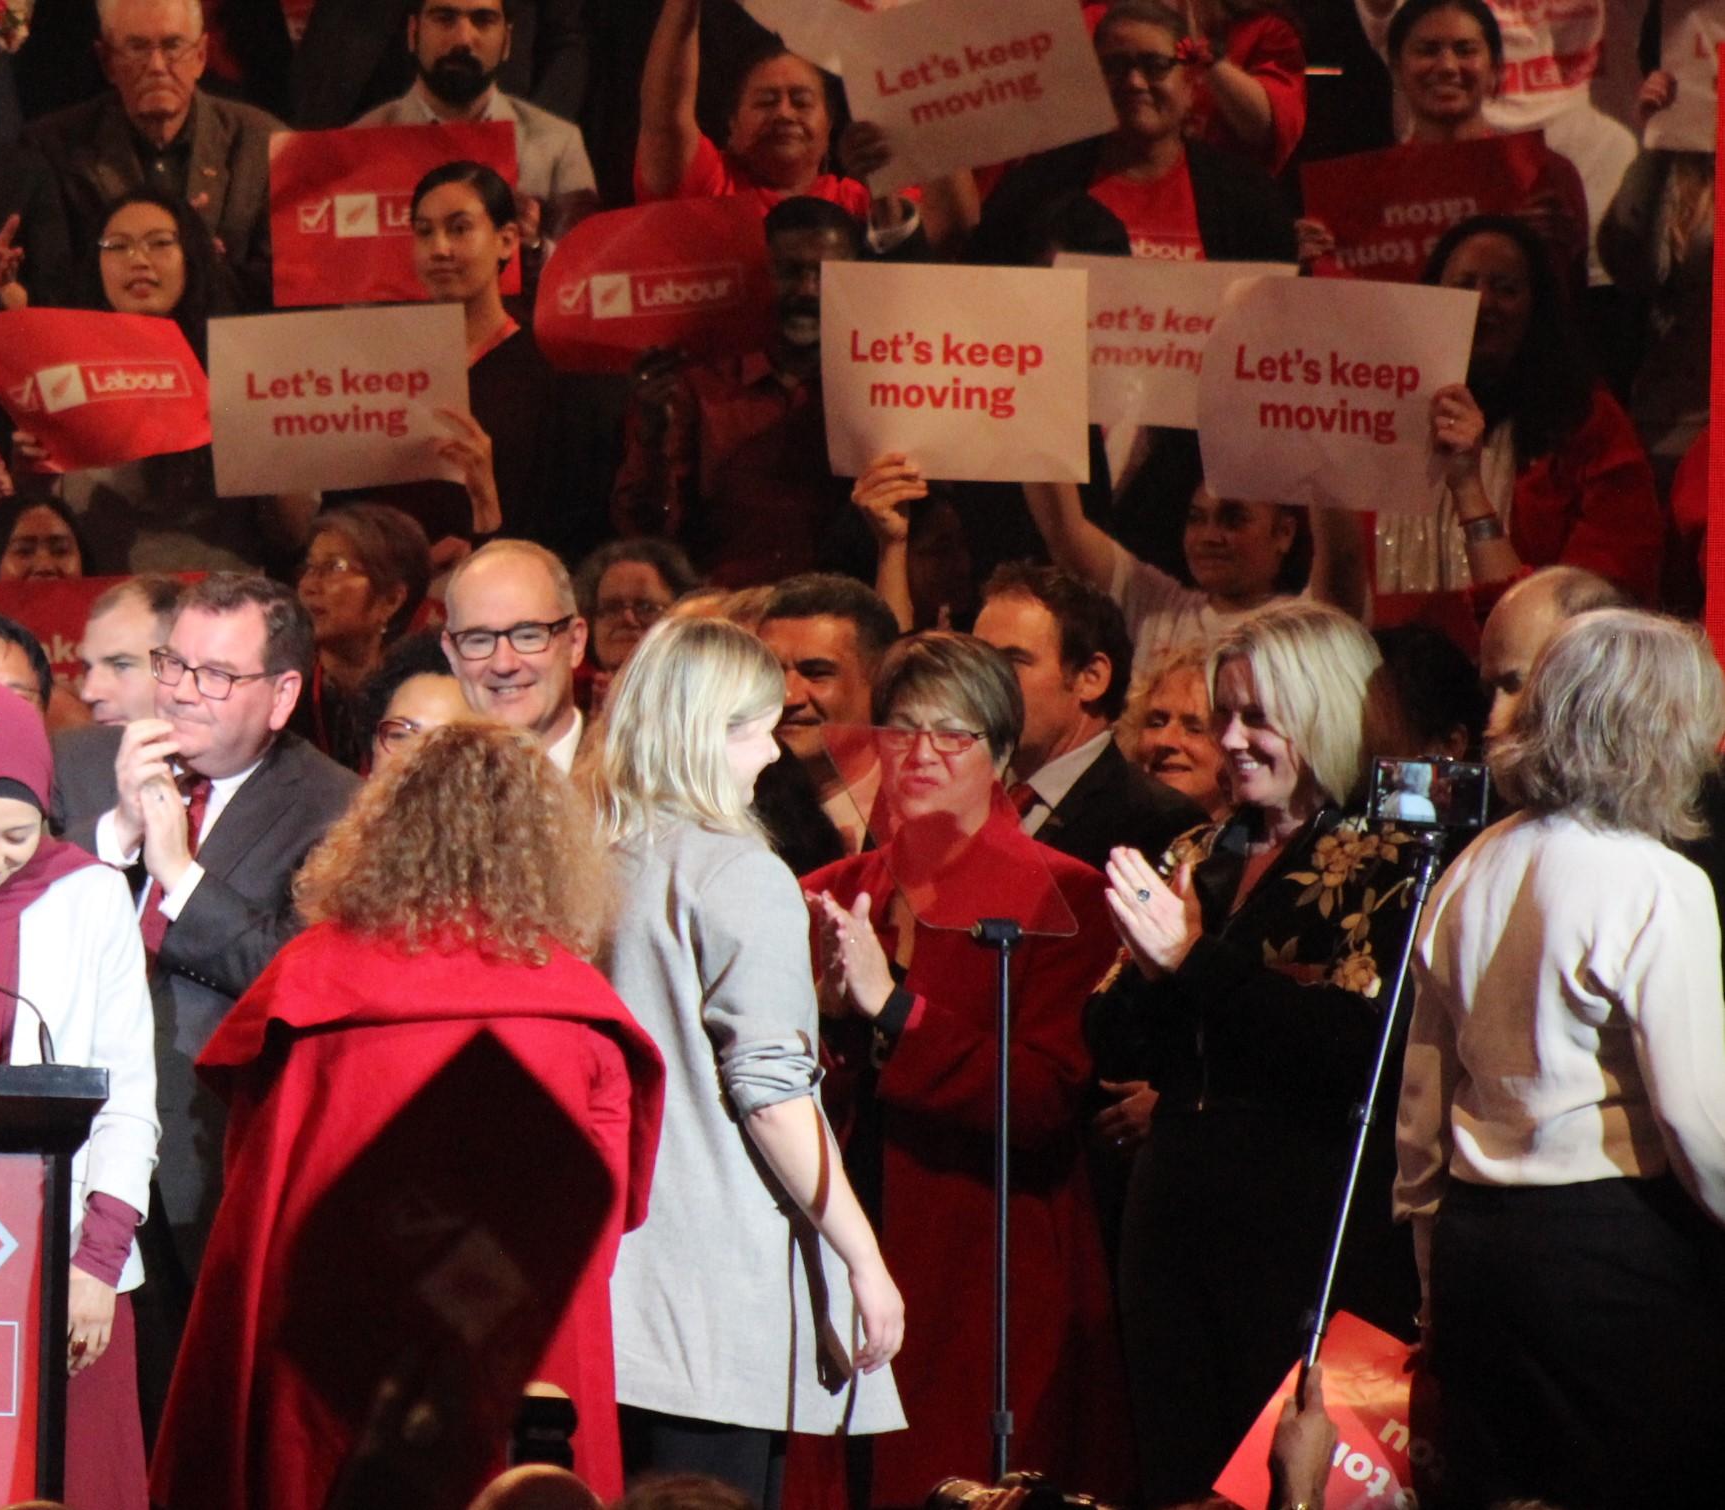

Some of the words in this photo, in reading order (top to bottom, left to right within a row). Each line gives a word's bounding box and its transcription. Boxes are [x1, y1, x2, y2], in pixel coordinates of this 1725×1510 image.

[876, 56, 960, 98] Let's
[963, 30, 1054, 70] keep
[909, 69, 1045, 125] moving
[637, 280, 732, 307] Labour
[1088, 306, 1155, 332] et's
[850, 330, 933, 366] Let's
[942, 332, 1044, 375] keep
[1234, 344, 1321, 384] Let's
[1330, 355, 1420, 397] keep
[88, 368, 176, 393] Labour
[247, 370, 332, 401] Let's
[340, 365, 430, 399] keep
[869, 378, 1016, 419] moving
[272, 404, 408, 438] moving
[1259, 399, 1397, 446] moving
